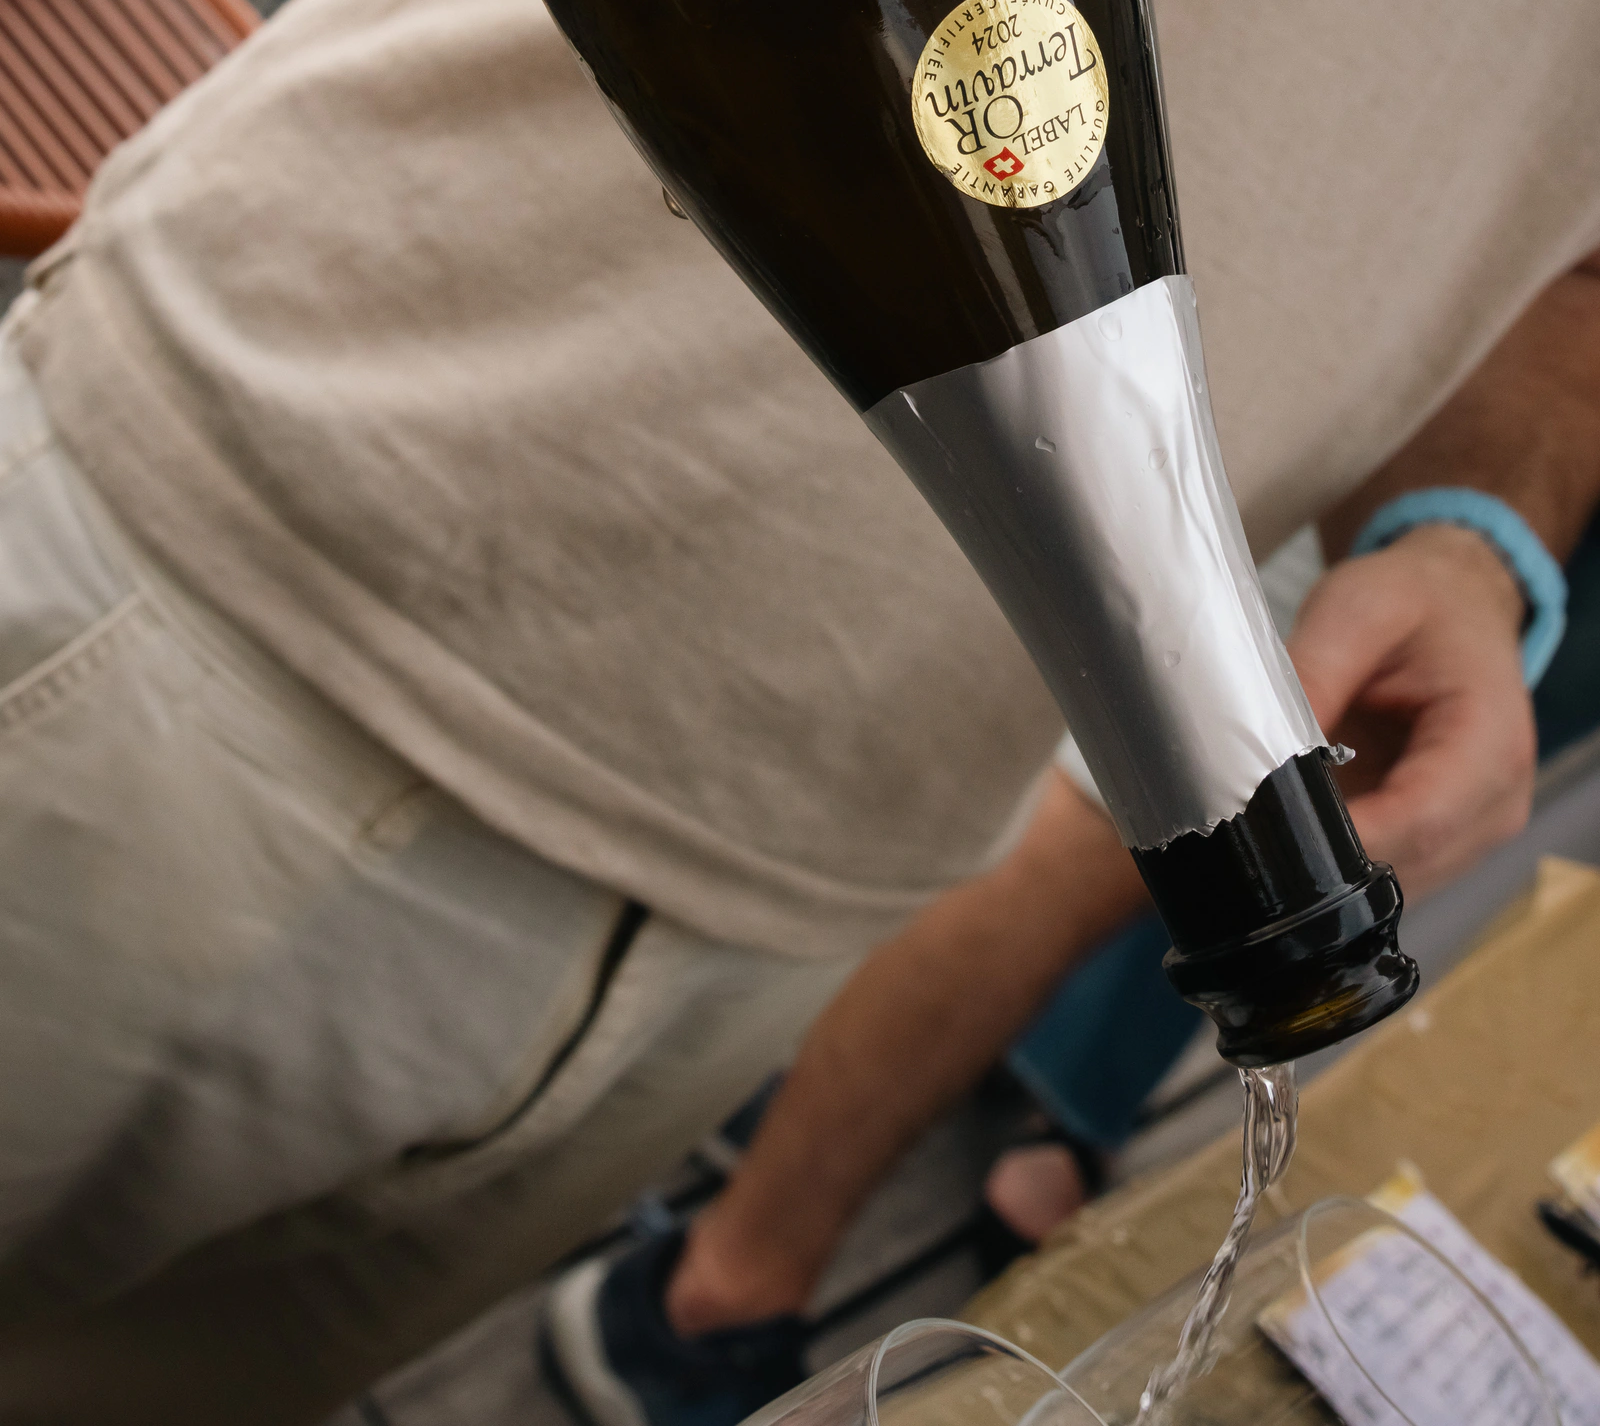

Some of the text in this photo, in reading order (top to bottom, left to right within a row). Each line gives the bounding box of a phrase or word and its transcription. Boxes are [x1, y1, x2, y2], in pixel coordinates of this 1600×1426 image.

[971, 13, 1023, 56] 2024
[924, 22, 1097, 118] Terravin
[944, 94, 1024, 156] OR
[951, 99, 1105, 199] QUALITÉ GARANTIE
[1012, 103, 1088, 156] LABEL
